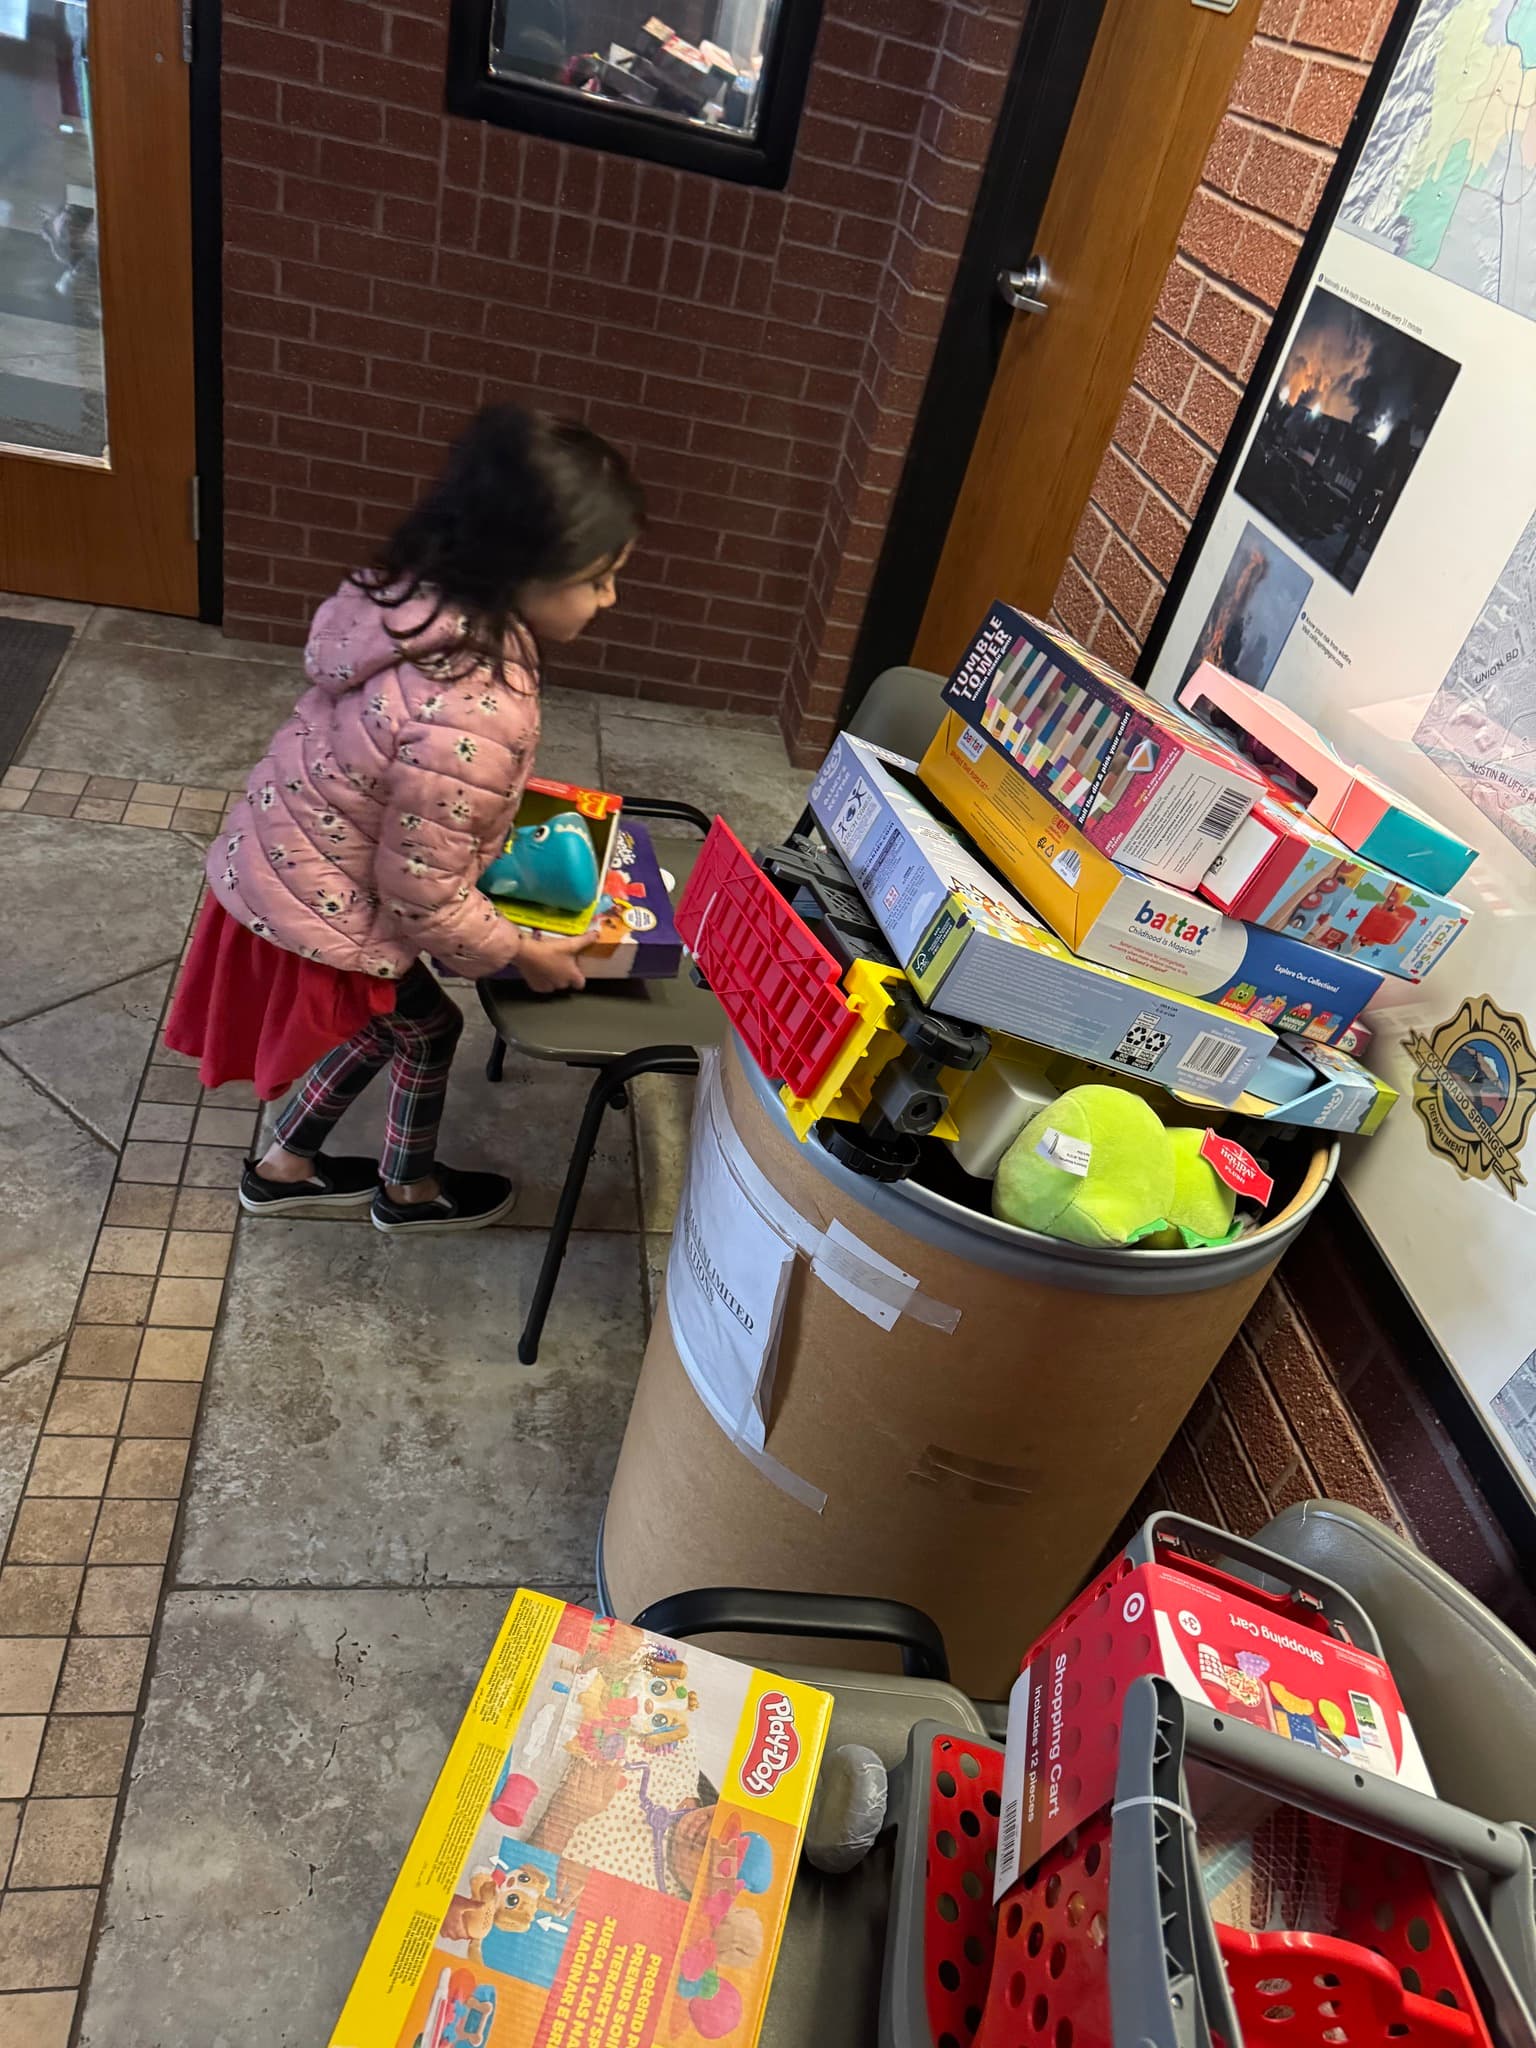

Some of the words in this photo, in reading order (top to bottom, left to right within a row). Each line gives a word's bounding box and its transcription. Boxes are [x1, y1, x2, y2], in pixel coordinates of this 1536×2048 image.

[949, 616, 1003, 698] TUMBLE
[961, 628, 1010, 700] TOWER
[1474, 659, 1504, 685] UNION
[962, 729, 985, 754] battat
[1108, 736, 1121, 755] your
[1096, 772, 1103, 780] &
[1099, 755, 1112, 773] pick
[1469, 760, 1498, 782] AUSTIN
[1499, 769, 1529, 799] BLUFFS
[1084, 795, 1094, 807] the
[1090, 781, 1100, 793] die
[1077, 808, 1088, 823] Roll
[1128, 925, 1162, 944] Childhood
[1134, 900, 1208, 946] battat
[1274, 963, 1296, 978] Explore
[1295, 972, 1308, 982] Our
[1499, 1022, 1523, 1053] FIRE
[1426, 1051, 1470, 1110] COLORADO
[1468, 1109, 1505, 1159] SPRINGS
[1428, 1103, 1467, 1156] DEPARTMENT
[1220, 1148, 1256, 1179] HOLIDAY
[1224, 1164, 1246, 1184] PLUSH
[697, 1236, 755, 1330] UNLIMITED
[1180, 1616, 1200, 1632] 3+
[1228, 1613, 1260, 1636] Cart
[1261, 1628, 1326, 1666] Shopping
[1050, 1652, 1068, 1761] Shopping
[746, 1697, 794, 1792] Play-Doh
[1030, 1755, 1040, 1773] 12
[1027, 1774, 1039, 1823] pieces
[1047, 1765, 1063, 1820] Cart
[590, 1915, 618, 1971] JUEGA
[559, 1919, 598, 2006] IMAGINAR
[585, 1970, 600, 1984] A
[616, 1942, 647, 2013] PRENDS
[575, 1985, 597, 2020] LAS
[593, 1944, 629, 2028] TIERARZT
[556, 2005, 571, 2020] E
[604, 2011, 627, 2048] SOI
